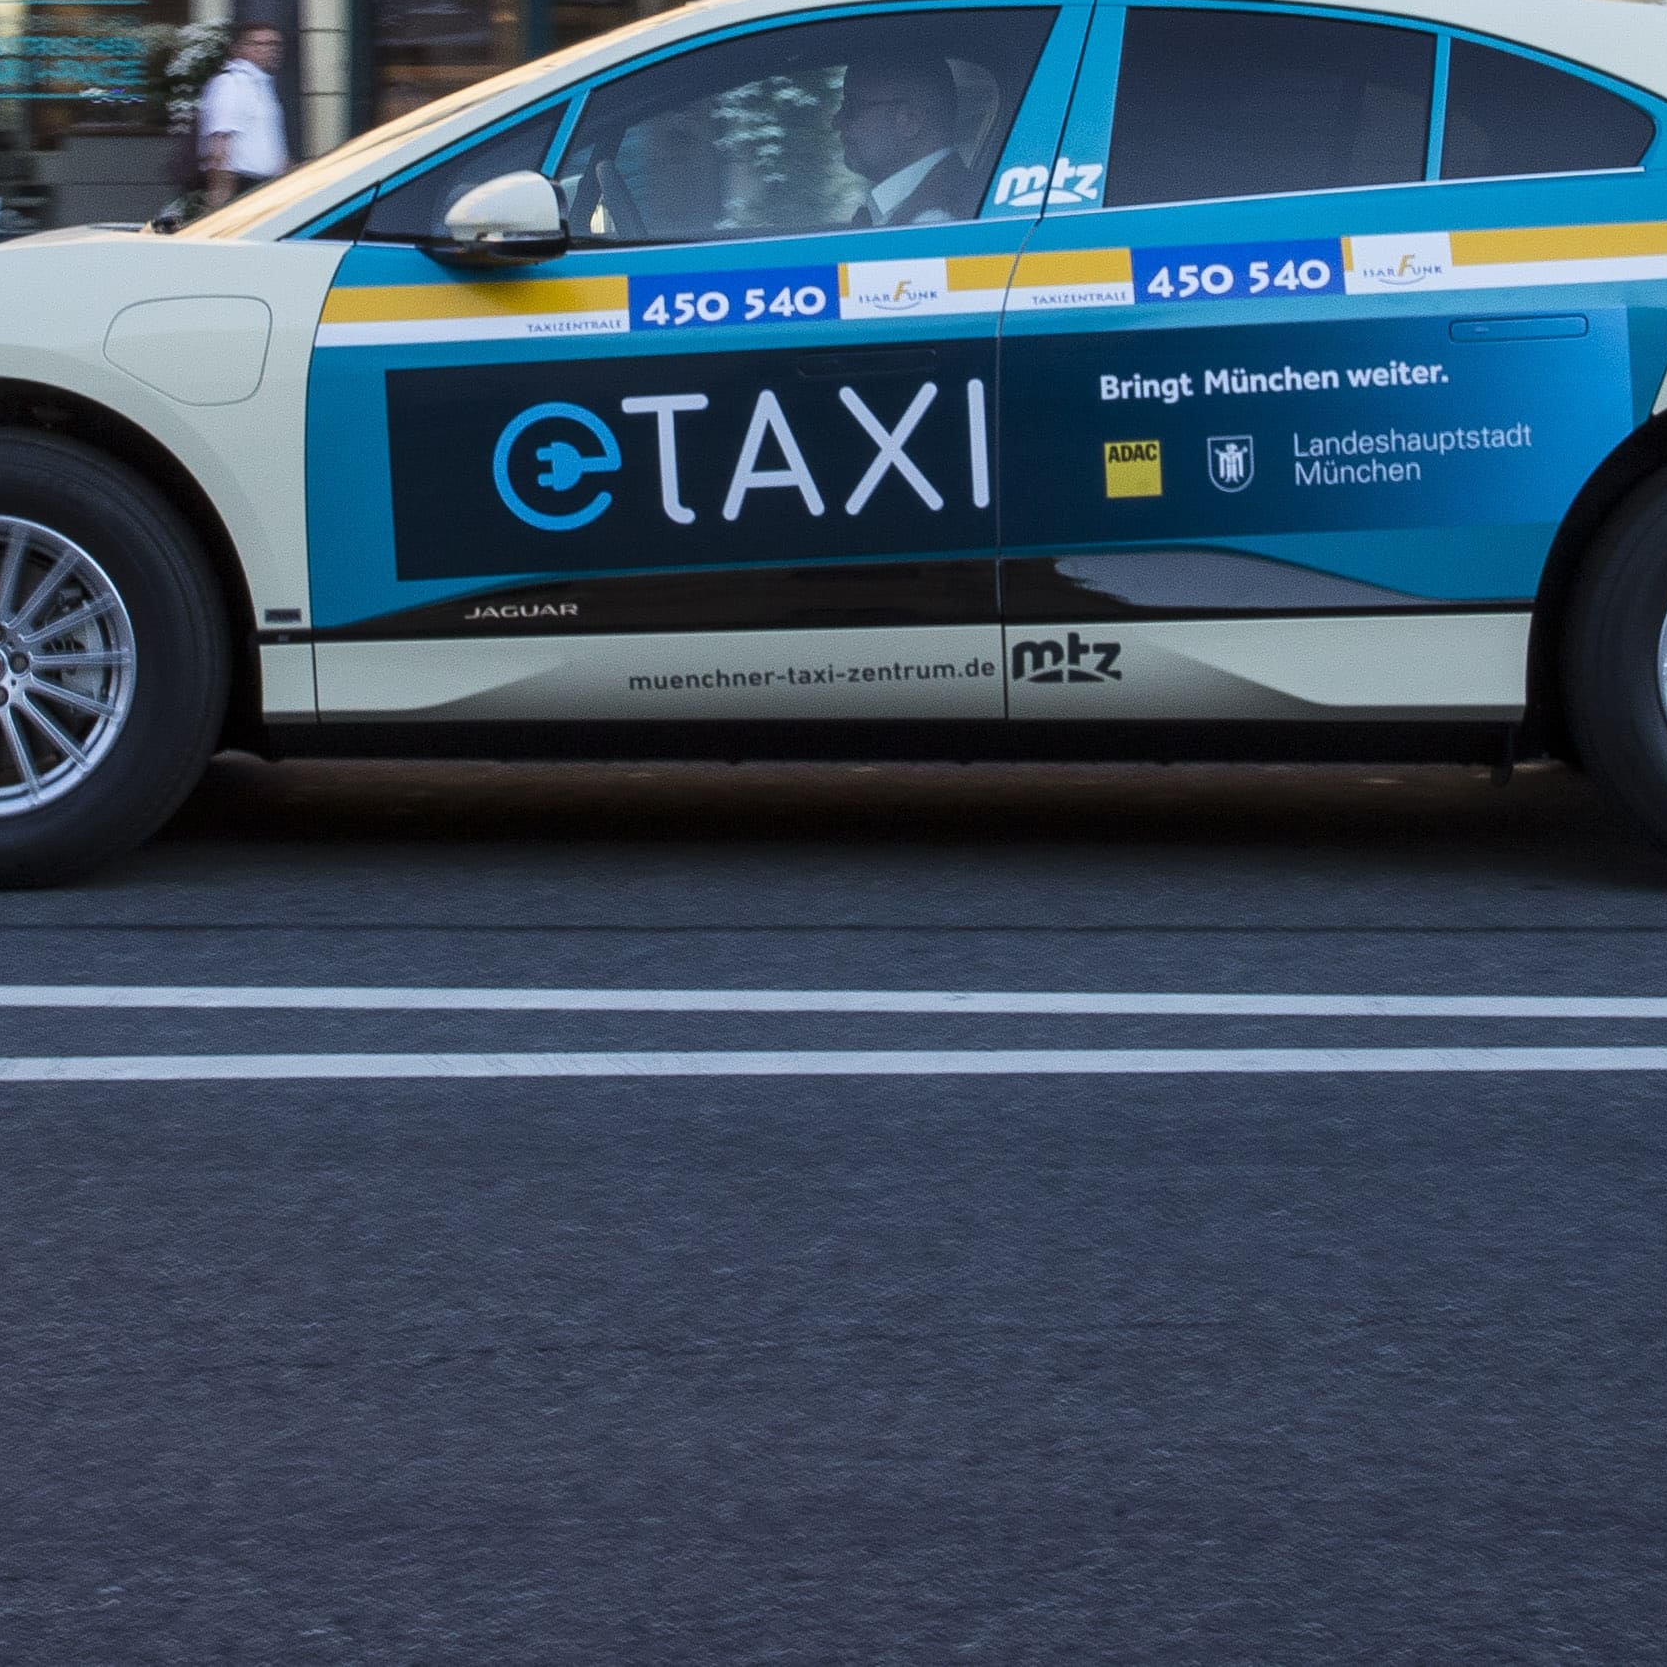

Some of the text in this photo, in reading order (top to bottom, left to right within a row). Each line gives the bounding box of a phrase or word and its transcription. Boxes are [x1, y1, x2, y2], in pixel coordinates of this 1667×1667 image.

[993, 156, 1104, 208] mtz
[1146, 259, 1331, 298] 450 540
[643, 285, 827, 326] 450 540
[1031, 291, 1127, 306] TAXIZENTRALE
[526, 318, 623, 334] TAXIZENTRALE
[1099, 359, 1450, 405] Bringt München weiter.
[492, 378, 991, 532] eTAXI
[1107, 442, 1159, 464] ADAC
[1292, 421, 1533, 458] Landeshauptstadt
[1294, 457, 1422, 486] München
[464, 602, 580, 620] JAGUAR
[628, 657, 996, 692] muenchner-taxi-zentrum.de
[1011, 631, 1123, 684] mtz
